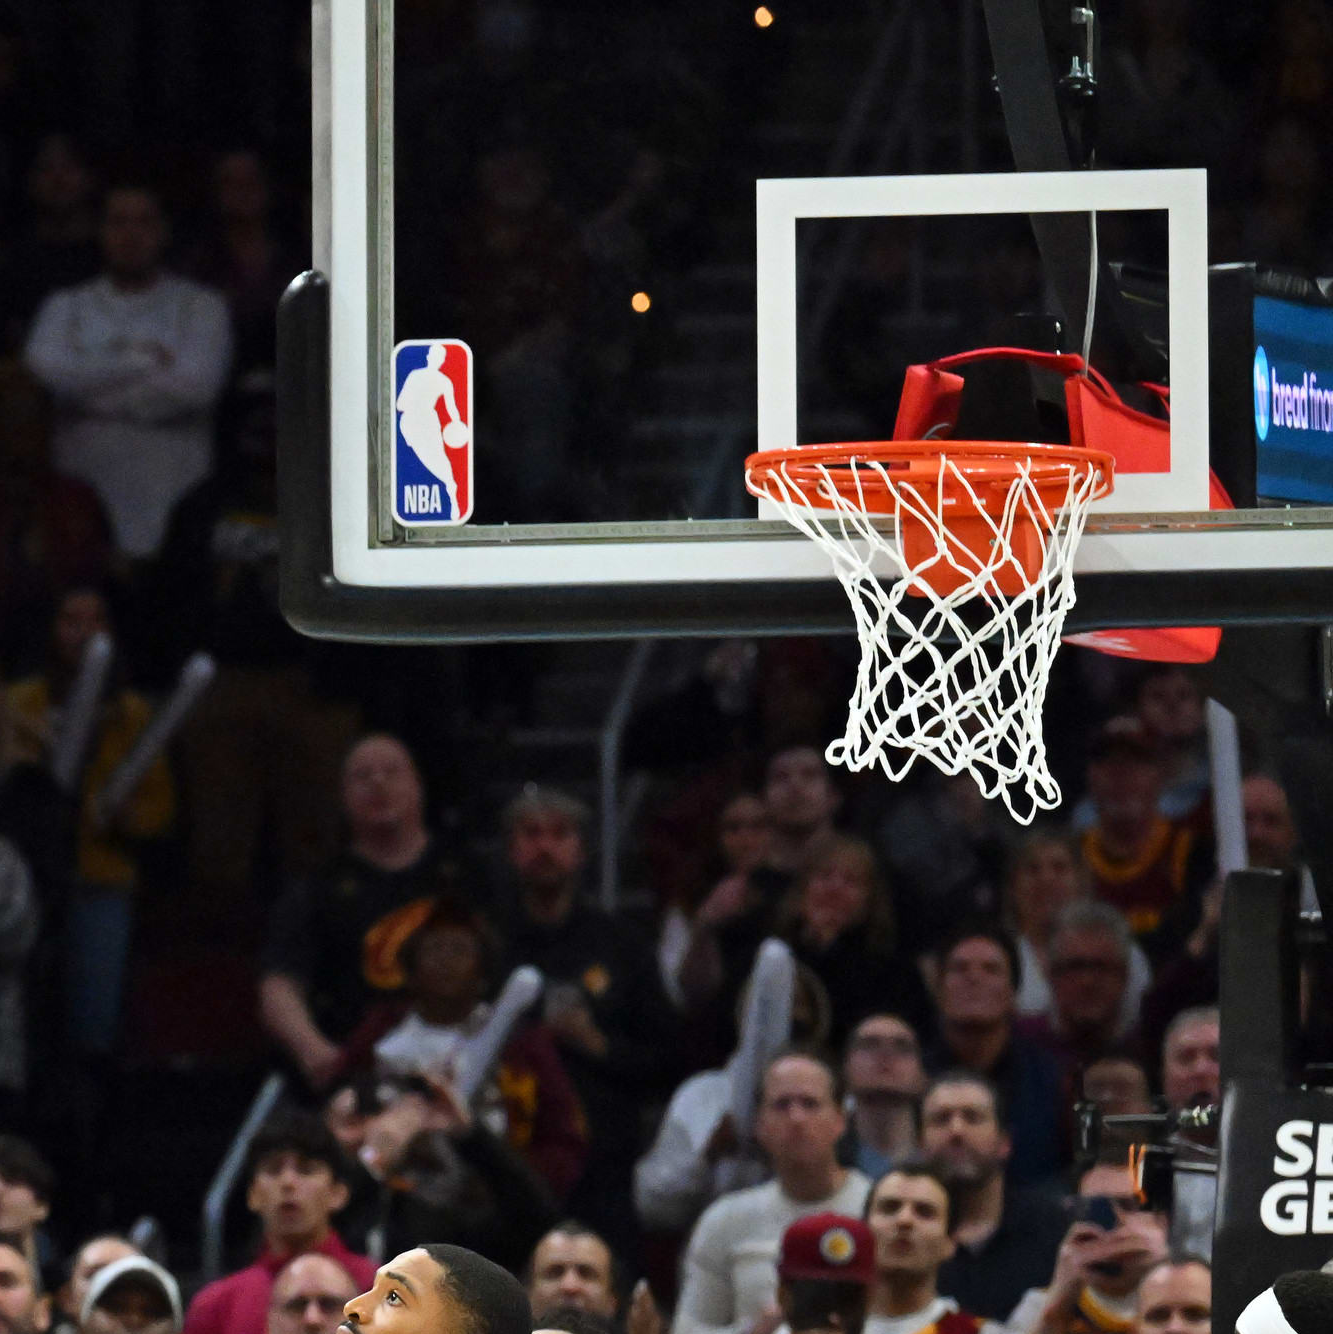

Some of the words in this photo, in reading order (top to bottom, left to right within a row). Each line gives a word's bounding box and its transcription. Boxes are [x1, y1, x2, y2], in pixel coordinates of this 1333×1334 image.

[1271, 366, 1308, 429] bread
[1309, 371, 1333, 432] fina
[404, 484, 442, 513] NBA
